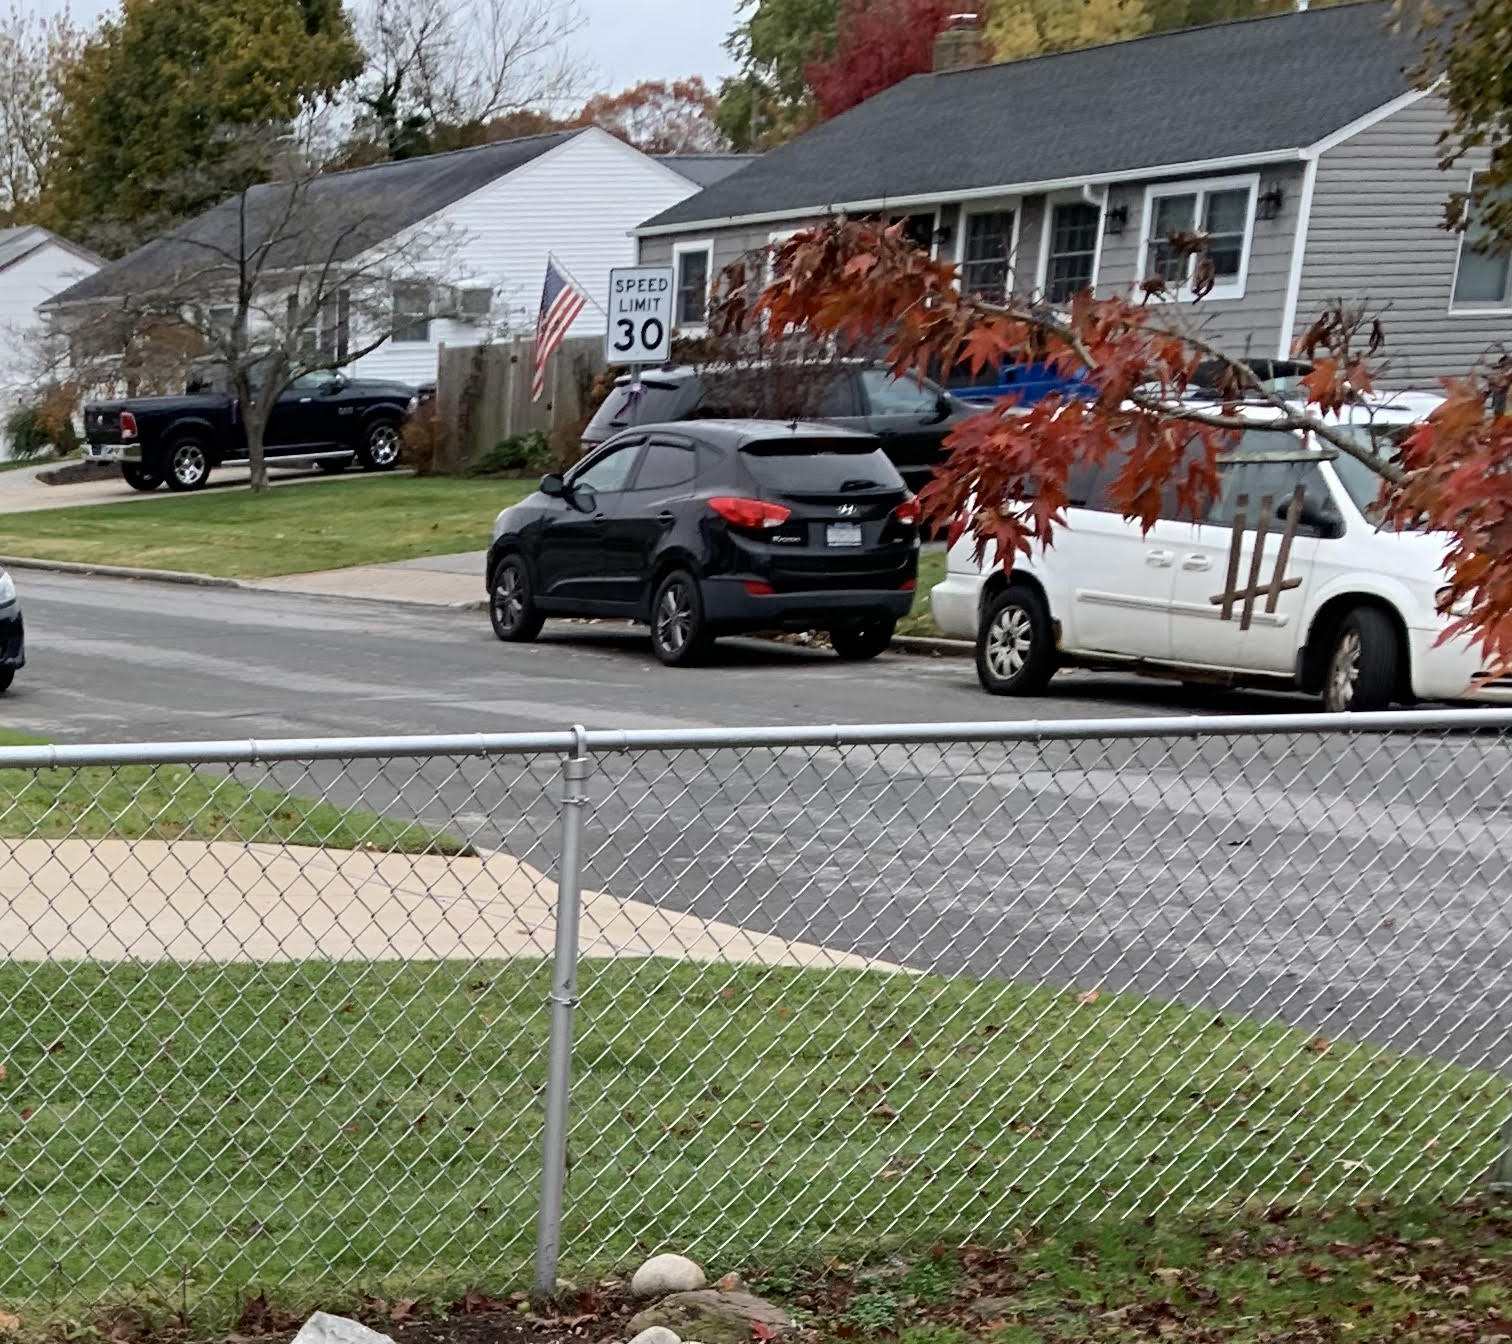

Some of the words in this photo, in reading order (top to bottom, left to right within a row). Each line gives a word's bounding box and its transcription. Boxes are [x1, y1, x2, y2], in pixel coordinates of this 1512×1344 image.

[616, 278, 668, 293] SPEED
[619, 298, 661, 312] LIMIT
[613, 317, 663, 351] 30
